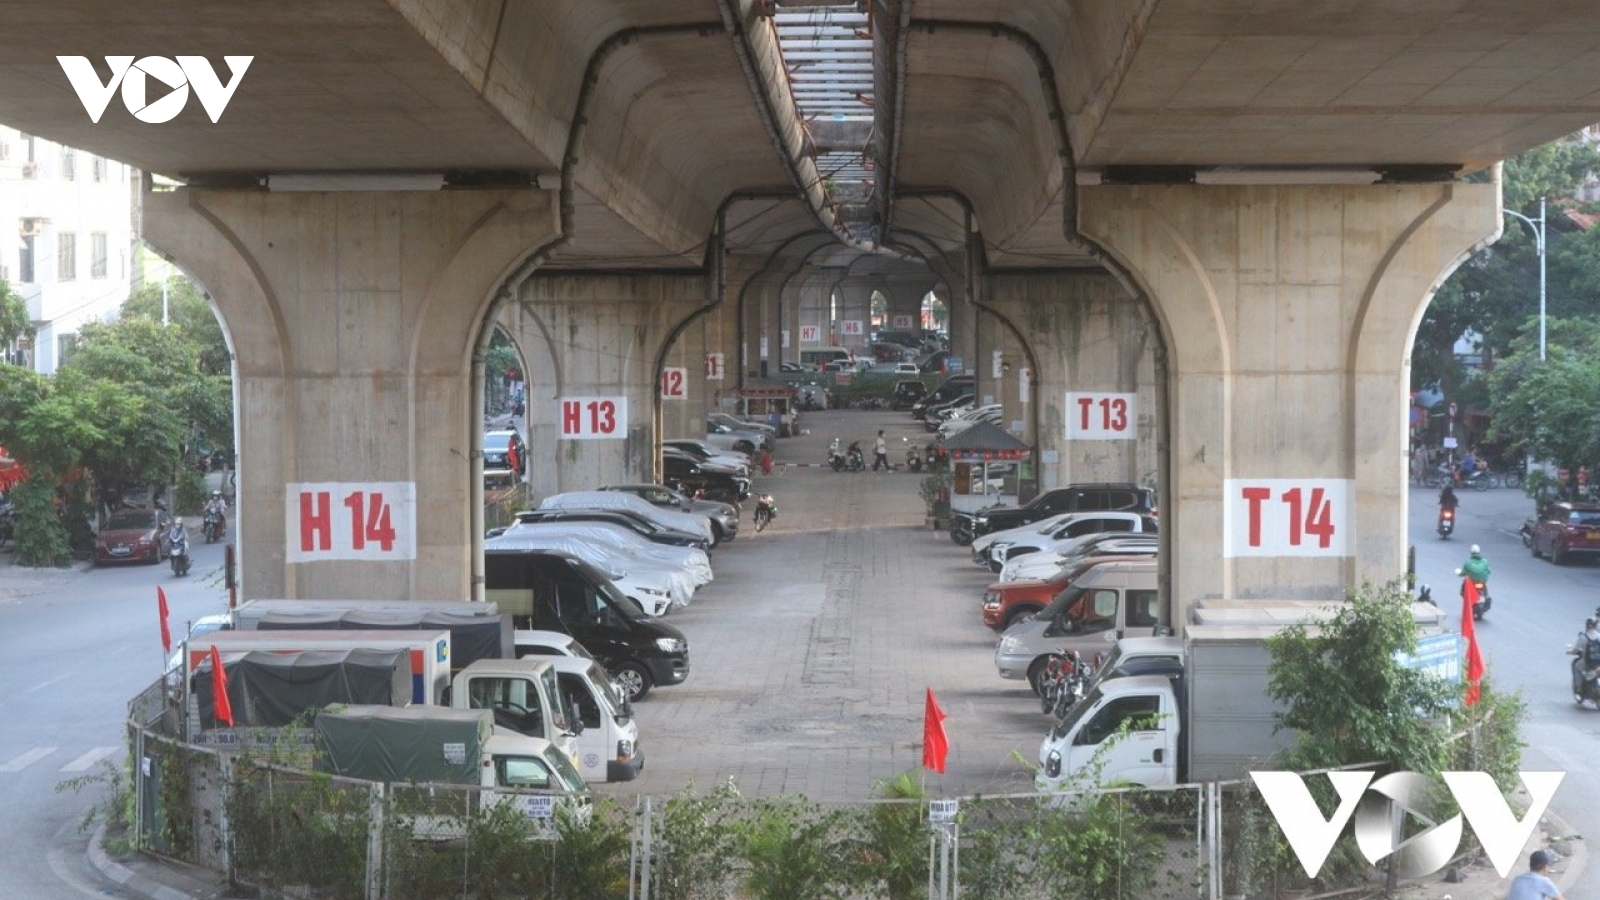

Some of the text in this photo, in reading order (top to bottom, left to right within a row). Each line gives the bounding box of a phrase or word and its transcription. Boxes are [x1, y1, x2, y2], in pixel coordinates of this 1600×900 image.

[803, 327, 815, 339] H7
[662, 370, 682, 395] 12
[563, 401, 616, 434] H 13
[1078, 398, 1127, 431] T 13
[300, 492, 395, 551] H 14
[1241, 488, 1335, 547] T 14
